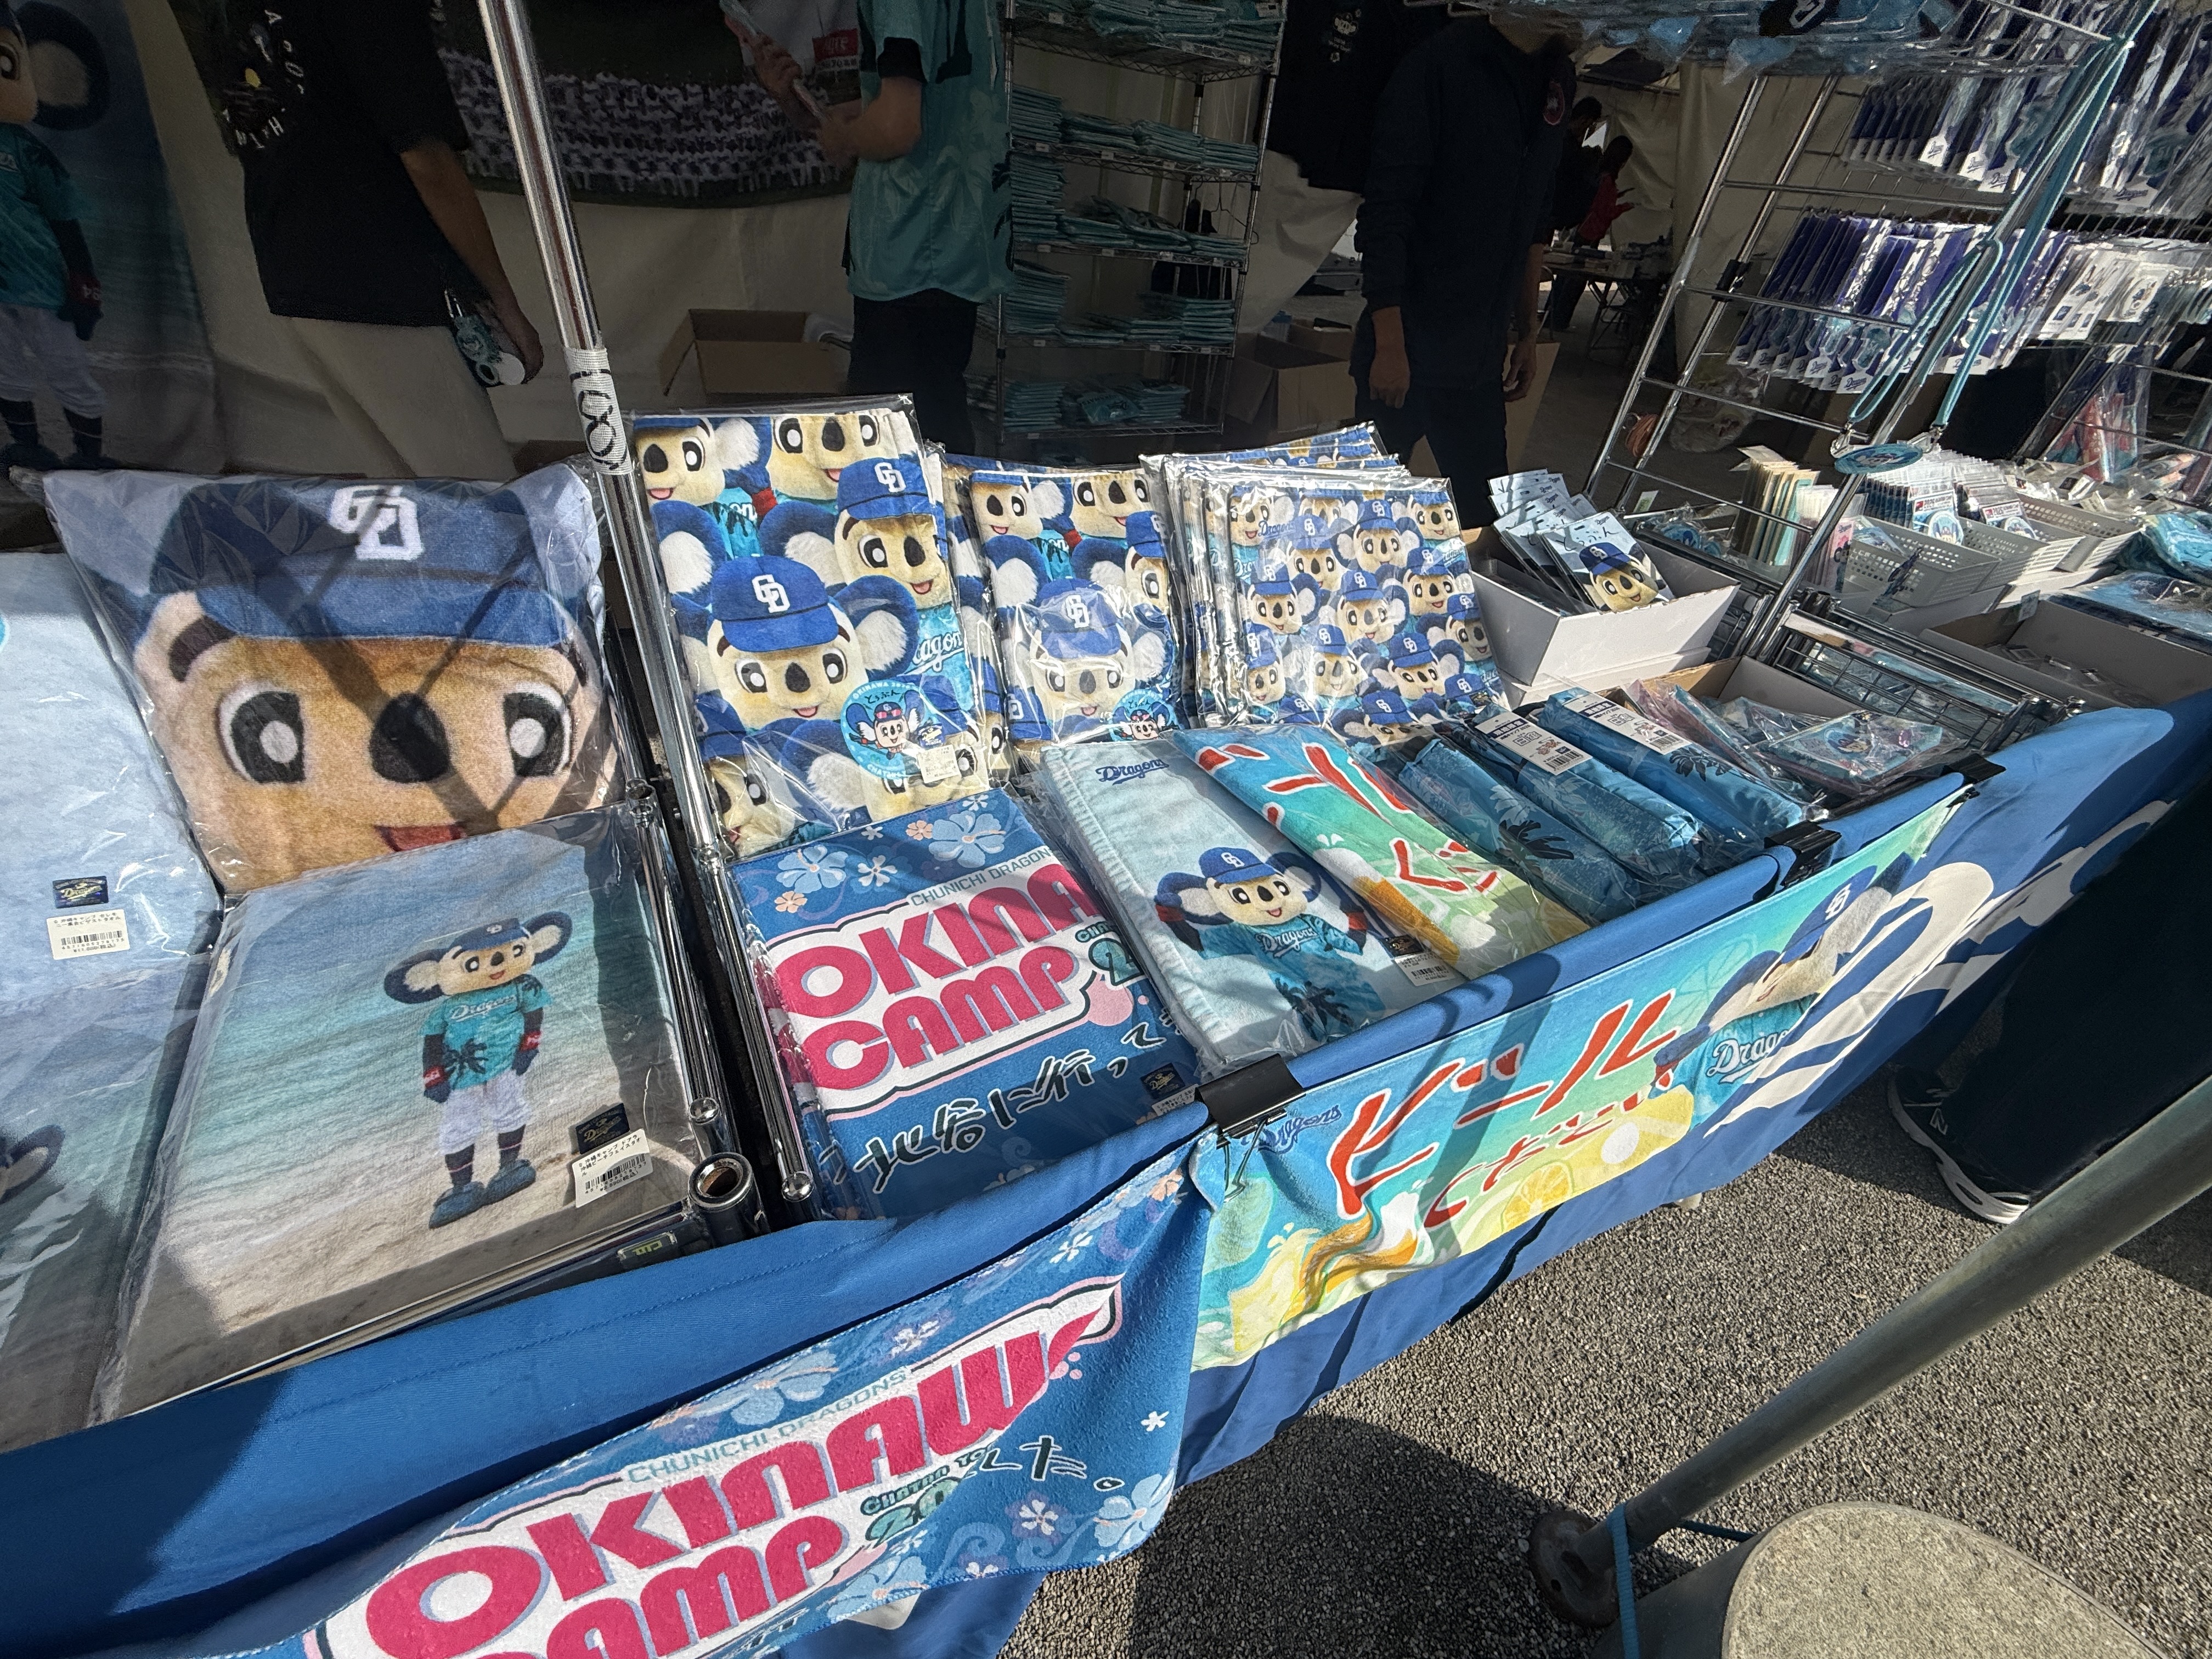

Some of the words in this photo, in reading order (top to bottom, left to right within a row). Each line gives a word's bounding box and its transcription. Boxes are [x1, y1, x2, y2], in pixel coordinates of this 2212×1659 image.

[910, 872, 986, 906] CHUNICHI
[802, 945, 1074, 1090] CAMP
[628, 1435, 768, 1483] CHUNICHI
[771, 1370, 907, 1435] DRAGONS
[477, 1515, 844, 1659] AMP
